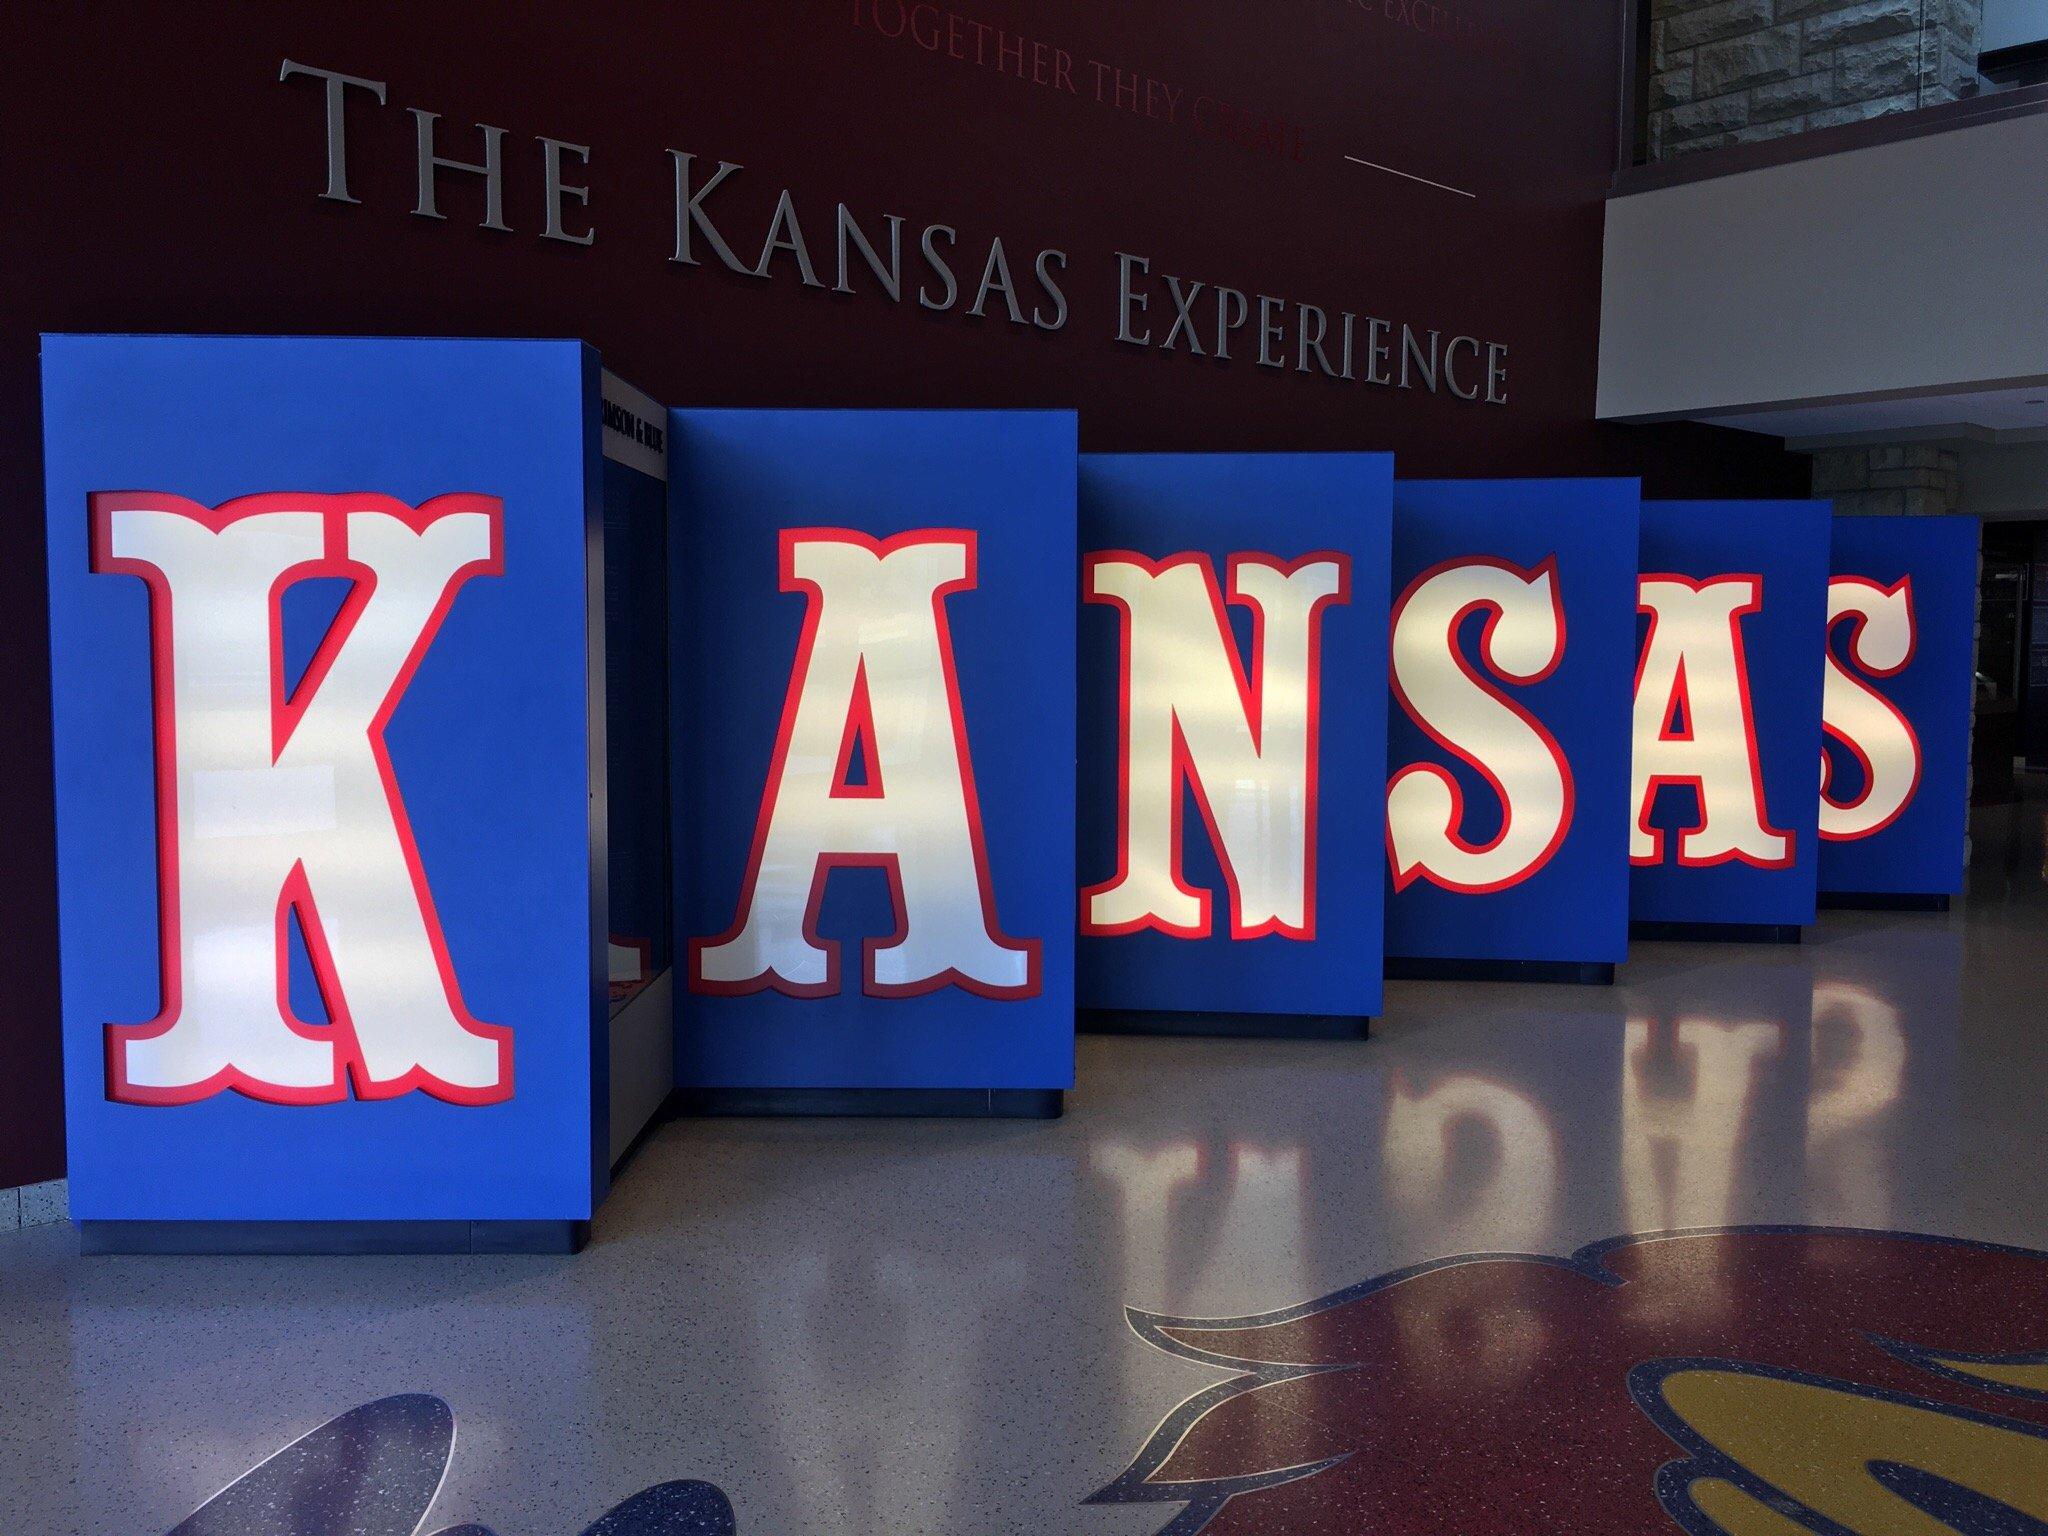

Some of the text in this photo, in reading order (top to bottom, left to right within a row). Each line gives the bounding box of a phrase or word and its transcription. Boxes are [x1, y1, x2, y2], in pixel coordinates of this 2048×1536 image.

[849, 0, 1077, 95] TOGETHER
[1087, 59, 1184, 123] THEY
[278, 58, 1509, 405] THE KANSAS EXPERIENCE
